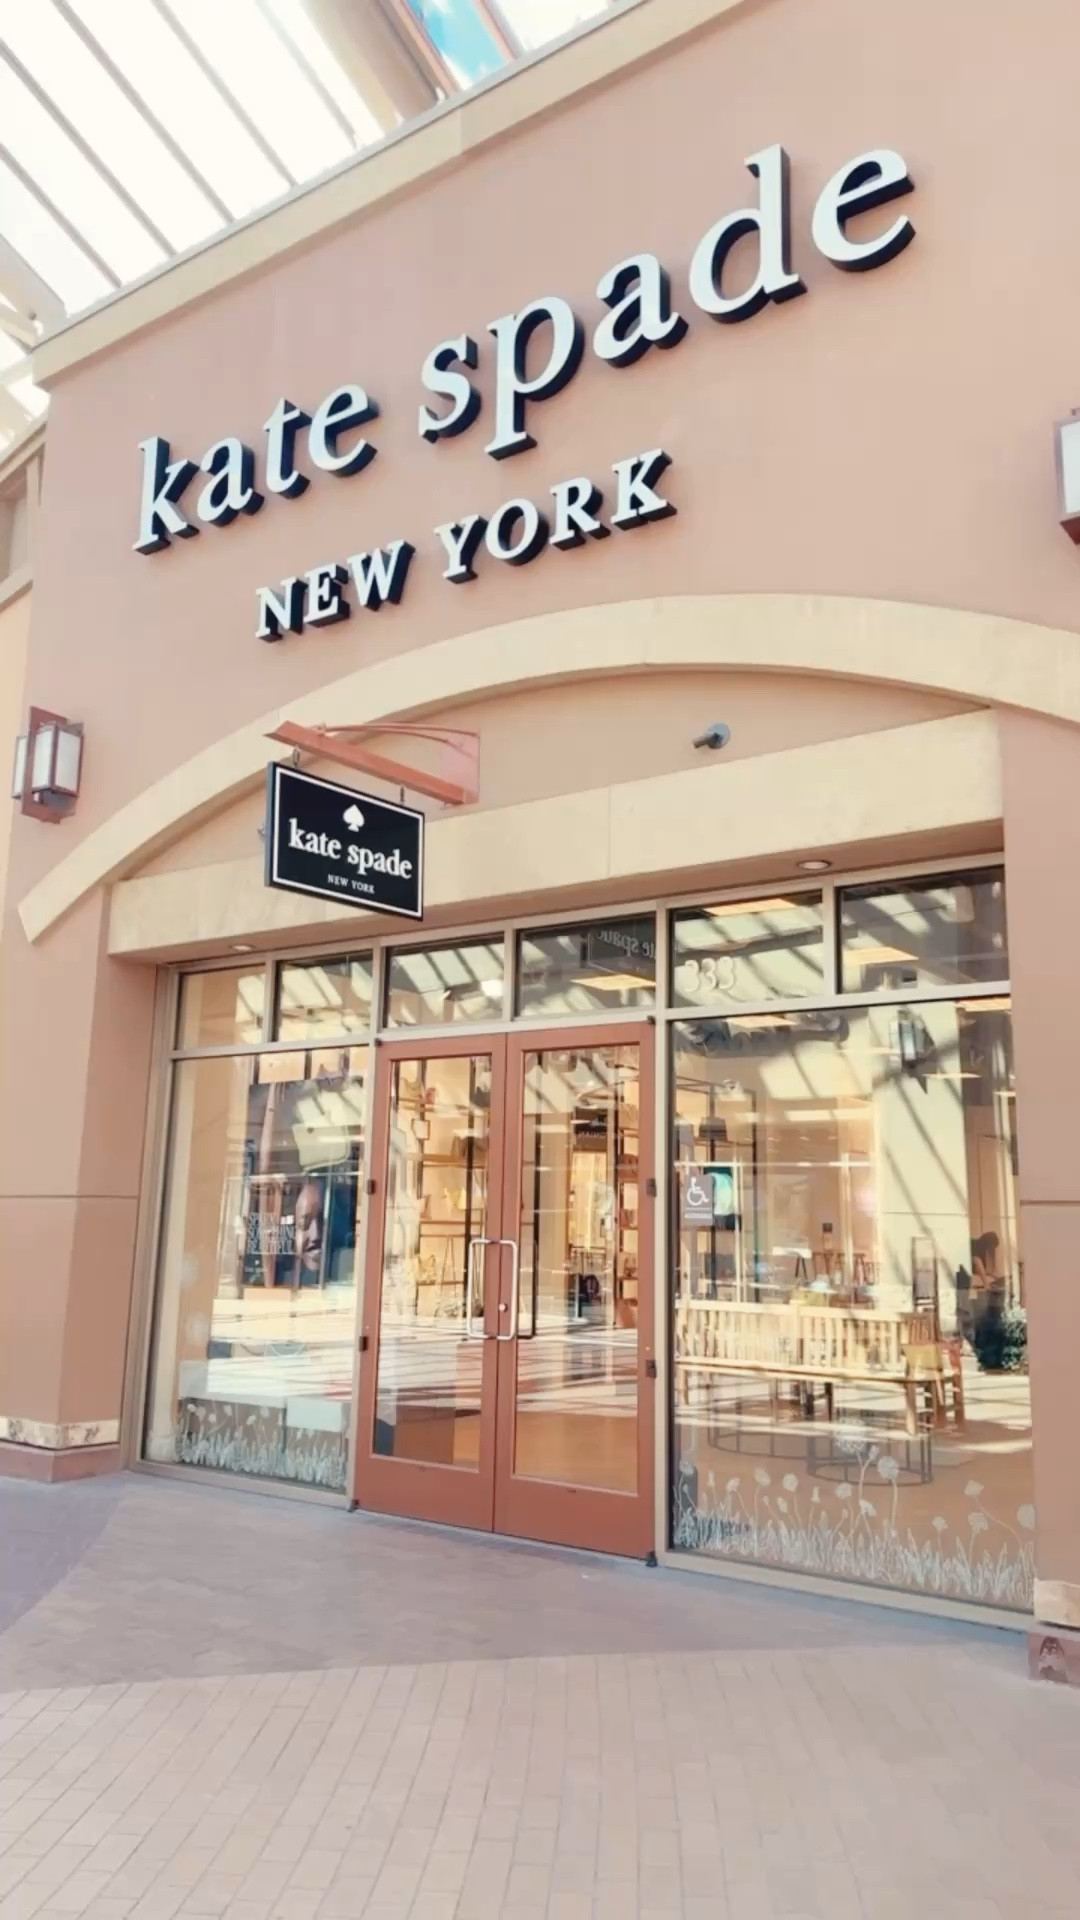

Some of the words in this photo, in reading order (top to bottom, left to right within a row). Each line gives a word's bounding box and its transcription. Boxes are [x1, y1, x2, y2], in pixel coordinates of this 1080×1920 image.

[132, 383, 380, 556] kate
[418, 144, 917, 460] spade
[255, 540, 415, 643] NEW
[434, 448, 678, 584] YORK
[288, 818, 341, 859] kate
[347, 844, 412, 879] spade
[328, 874, 349, 887] NEW
[352, 881, 374, 894] YORK
[683, 956, 734, 992] 333
